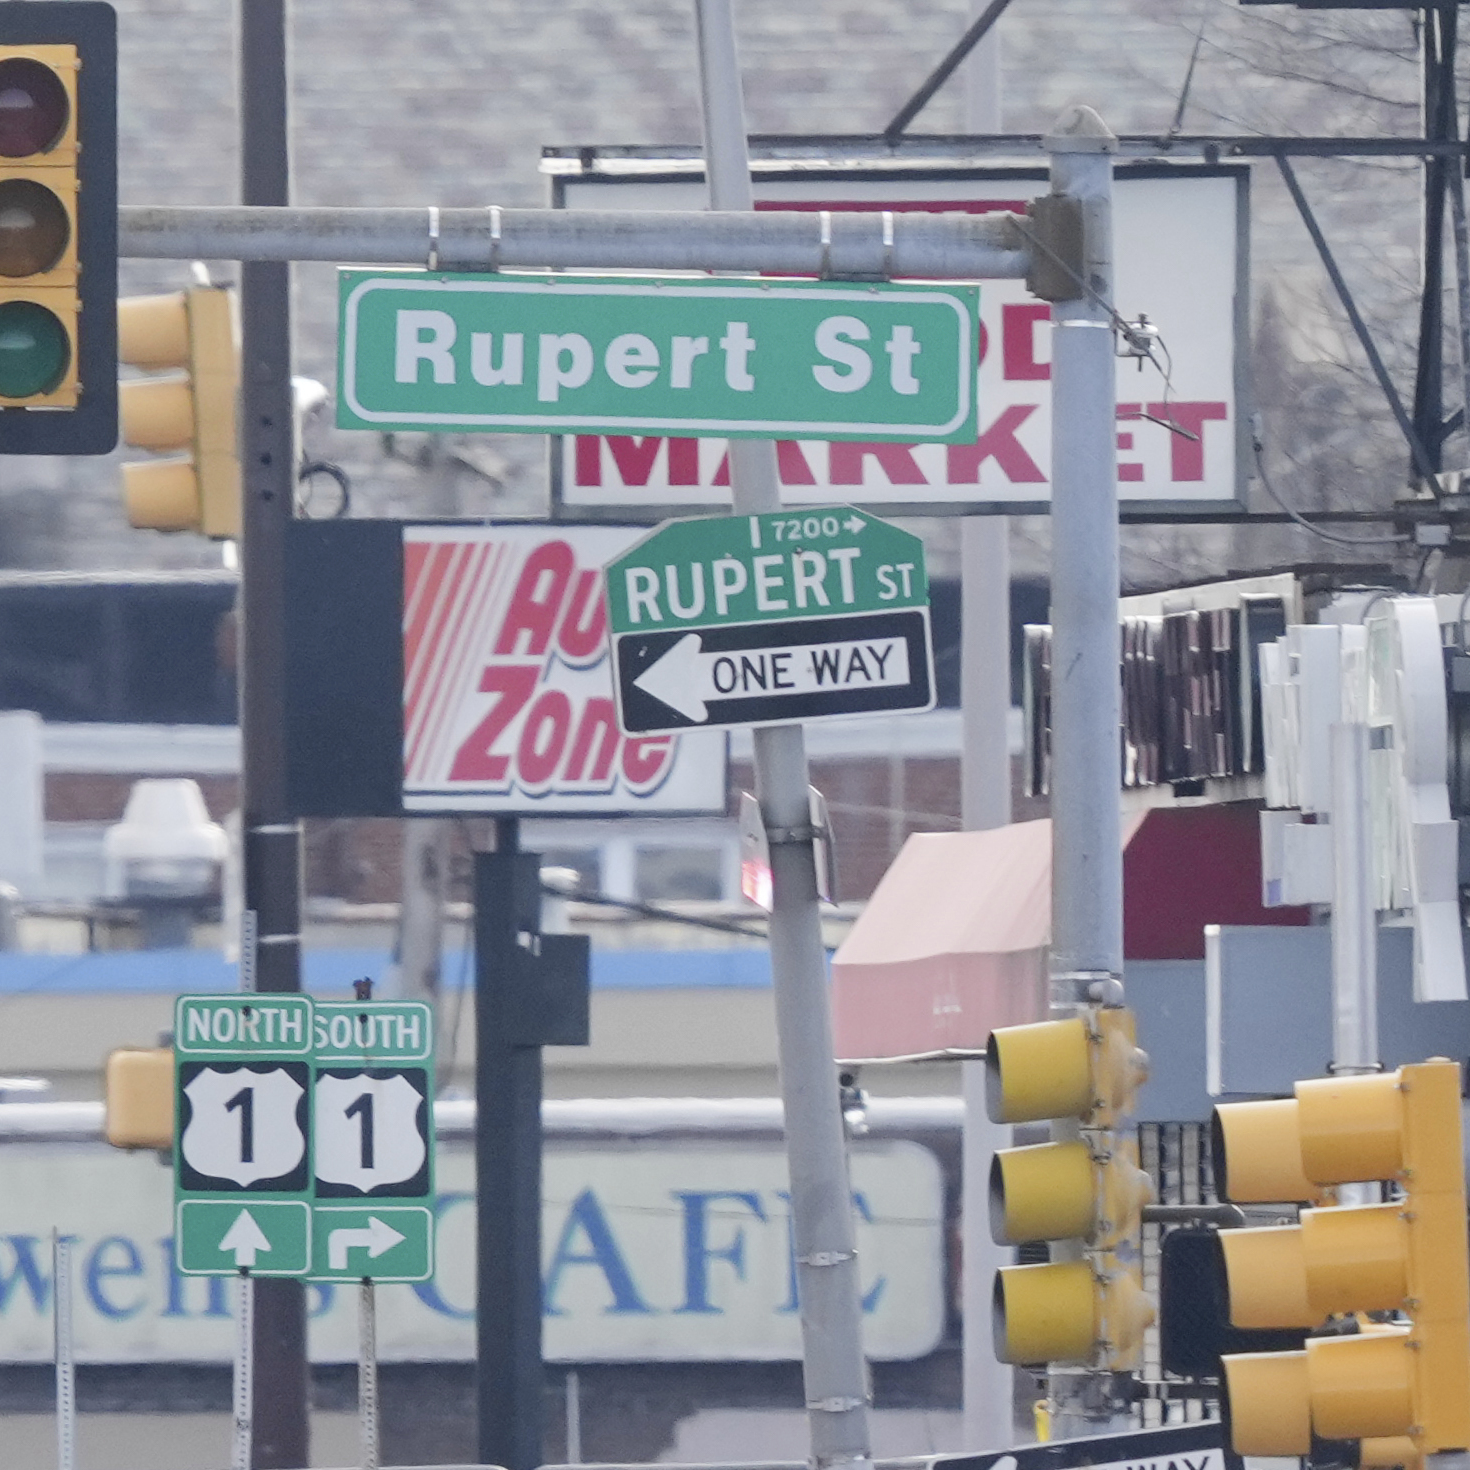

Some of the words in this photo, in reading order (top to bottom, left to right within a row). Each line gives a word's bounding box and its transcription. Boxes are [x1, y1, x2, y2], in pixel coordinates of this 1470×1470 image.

[393, 309, 756, 402] Rupert
[811, 315, 922, 395] St
[771, 516, 840, 542] 7200
[493, 540, 606, 657] Au
[625, 547, 861, 624] RUPERT
[876, 563, 915, 600] ST
[713, 653, 795, 694] ONE
[811, 644, 893, 686] WAY
[188, 1008, 303, 1044] NORTH
[314, 1014, 420, 1050] SOUTH
[224, 1087, 254, 1164] 1
[344, 1093, 375, 1170] 1
